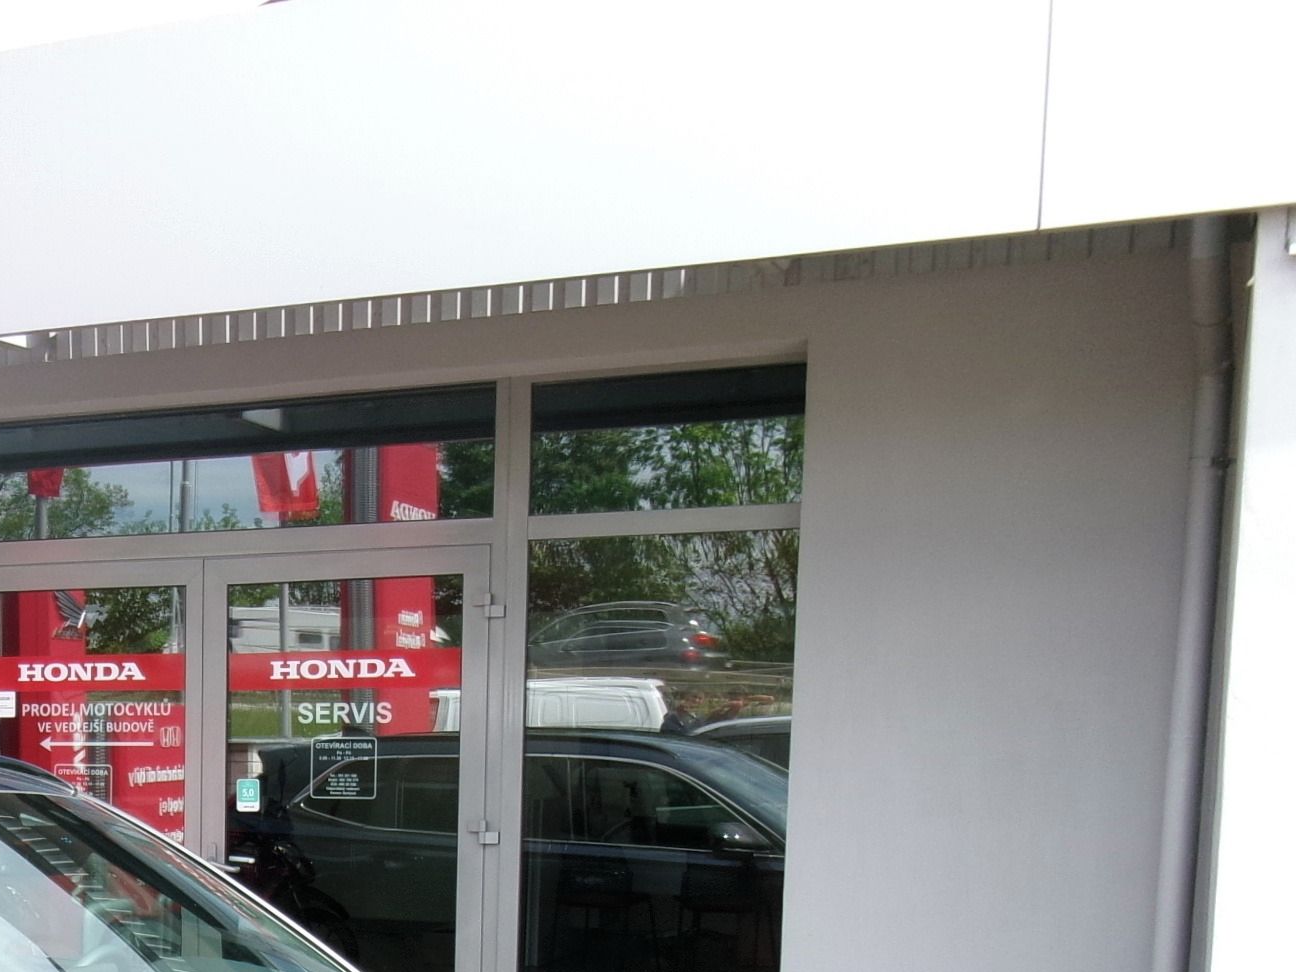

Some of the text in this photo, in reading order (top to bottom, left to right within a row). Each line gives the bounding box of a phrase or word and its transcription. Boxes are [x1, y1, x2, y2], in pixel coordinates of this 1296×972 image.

[18, 662, 146, 682] HONDA
[270, 658, 416, 680] HONDA
[22, 703, 74, 717] PRODEJ
[80, 698, 171, 717] MOTOCYKLŮ
[298, 702, 392, 724] SERVIS
[38, 722, 53, 733] VE
[106, 719, 154, 733] BUDOVĚ
